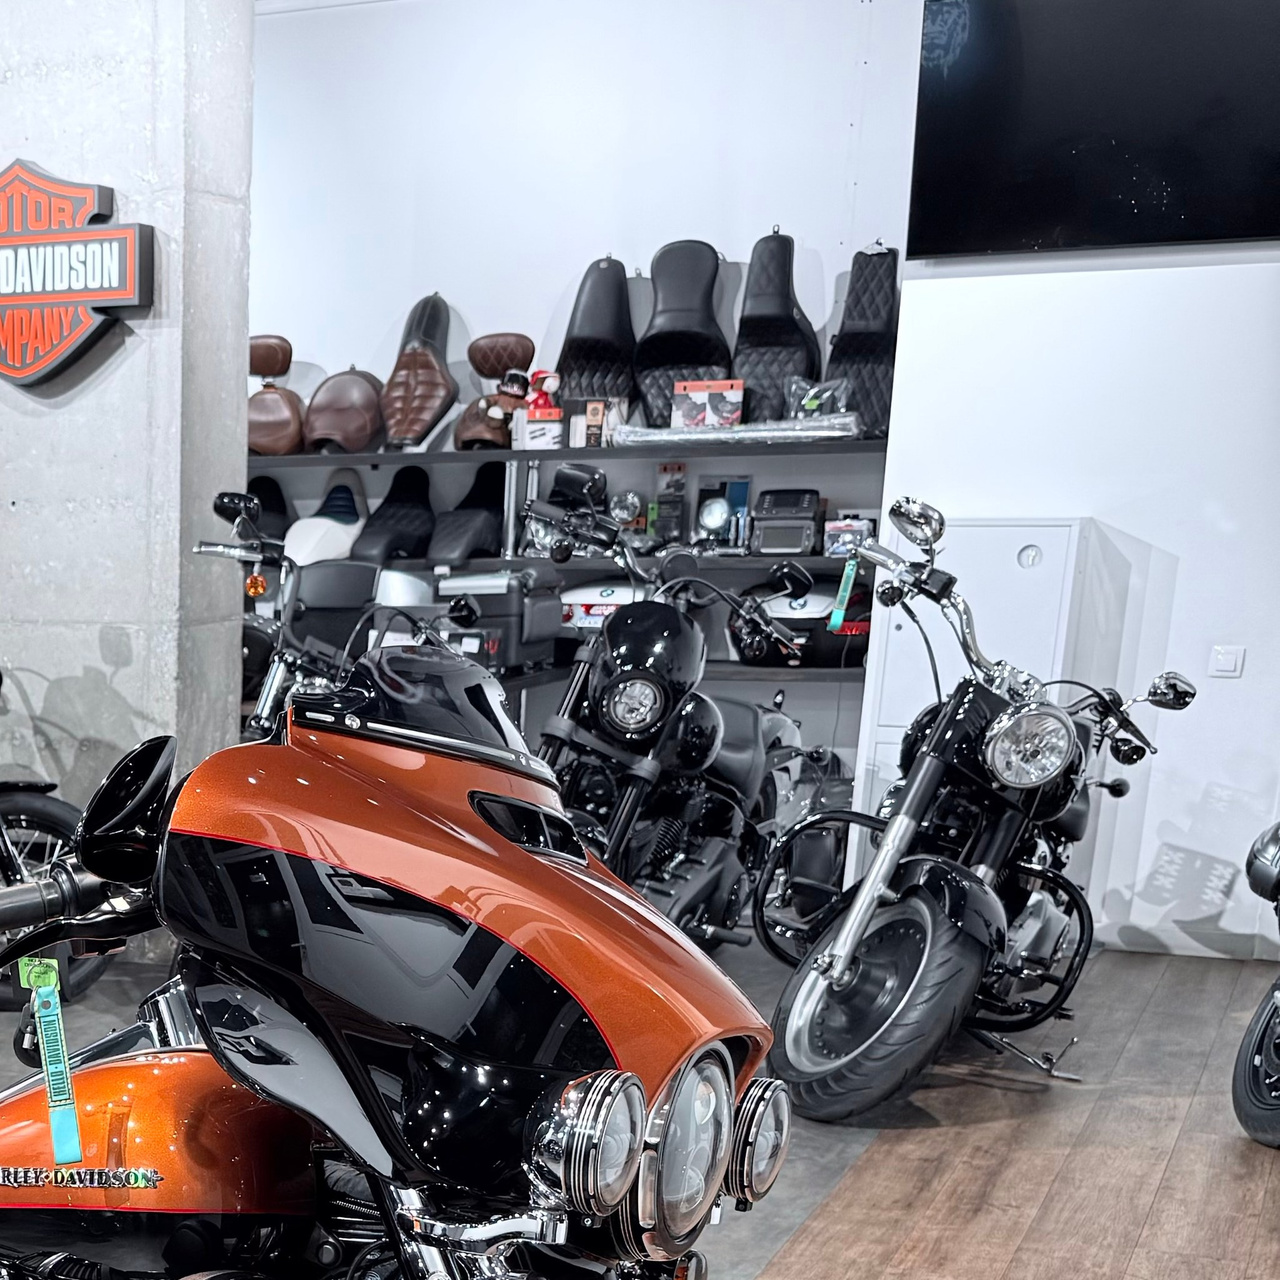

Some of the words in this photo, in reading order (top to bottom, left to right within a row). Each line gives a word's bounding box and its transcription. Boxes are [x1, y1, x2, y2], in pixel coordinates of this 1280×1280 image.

[0, 241, 120, 295] DAVIDSON
[42, 1019, 63, 1066] DAVIDSON
[50, 1070, 68, 1097] HELLO
